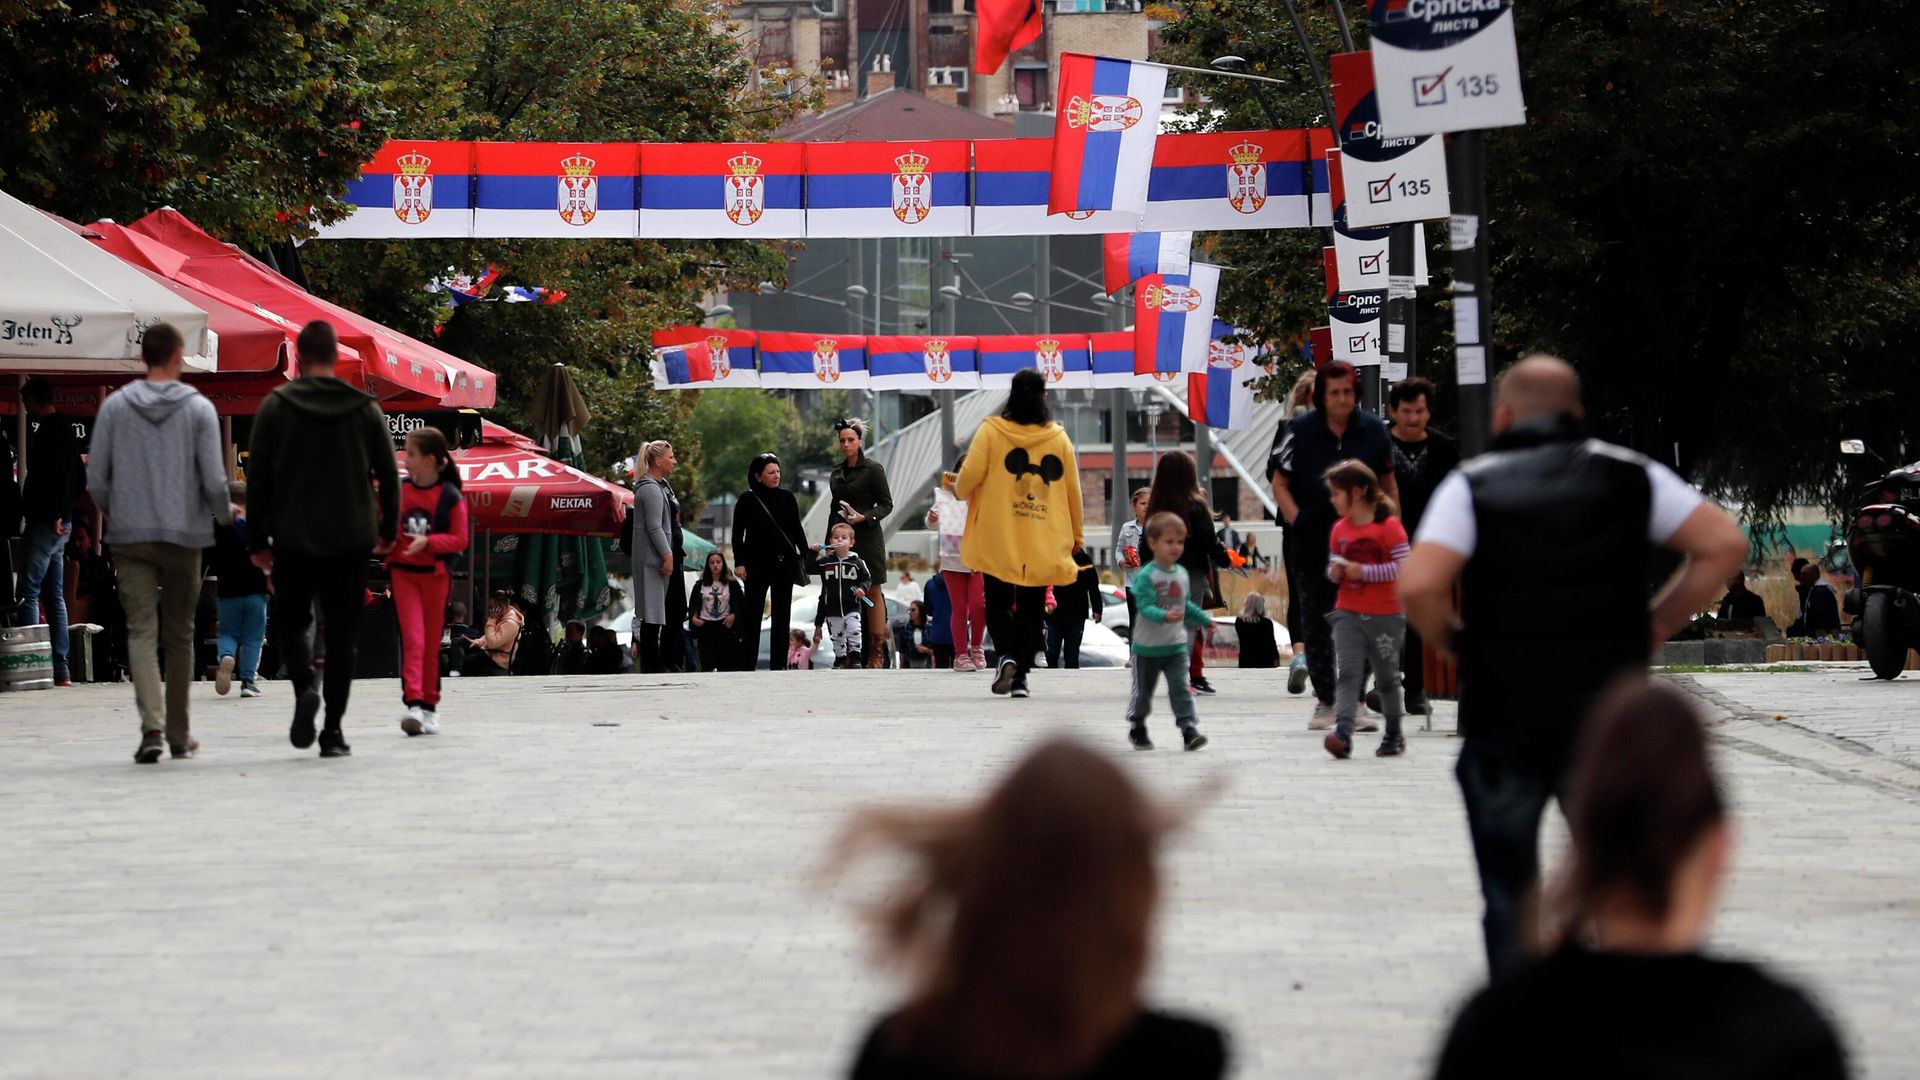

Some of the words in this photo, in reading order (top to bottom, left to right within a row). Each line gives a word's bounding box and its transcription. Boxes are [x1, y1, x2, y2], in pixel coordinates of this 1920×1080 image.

[1407, 0, 1501, 22] Српска
[1431, 17, 1480, 34] листа
[1456, 74, 1499, 98] 135
[1381, 136, 1416, 149] листа
[1398, 179, 1432, 197] 135
[1348, 294, 1381, 309] Српс
[1359, 307, 1380, 315] лист
[1, 319, 52, 341] Jelen
[456, 458, 557, 481] TAR
[550, 497, 593, 509] NEKTAR
[825, 565, 858, 580] FILA
